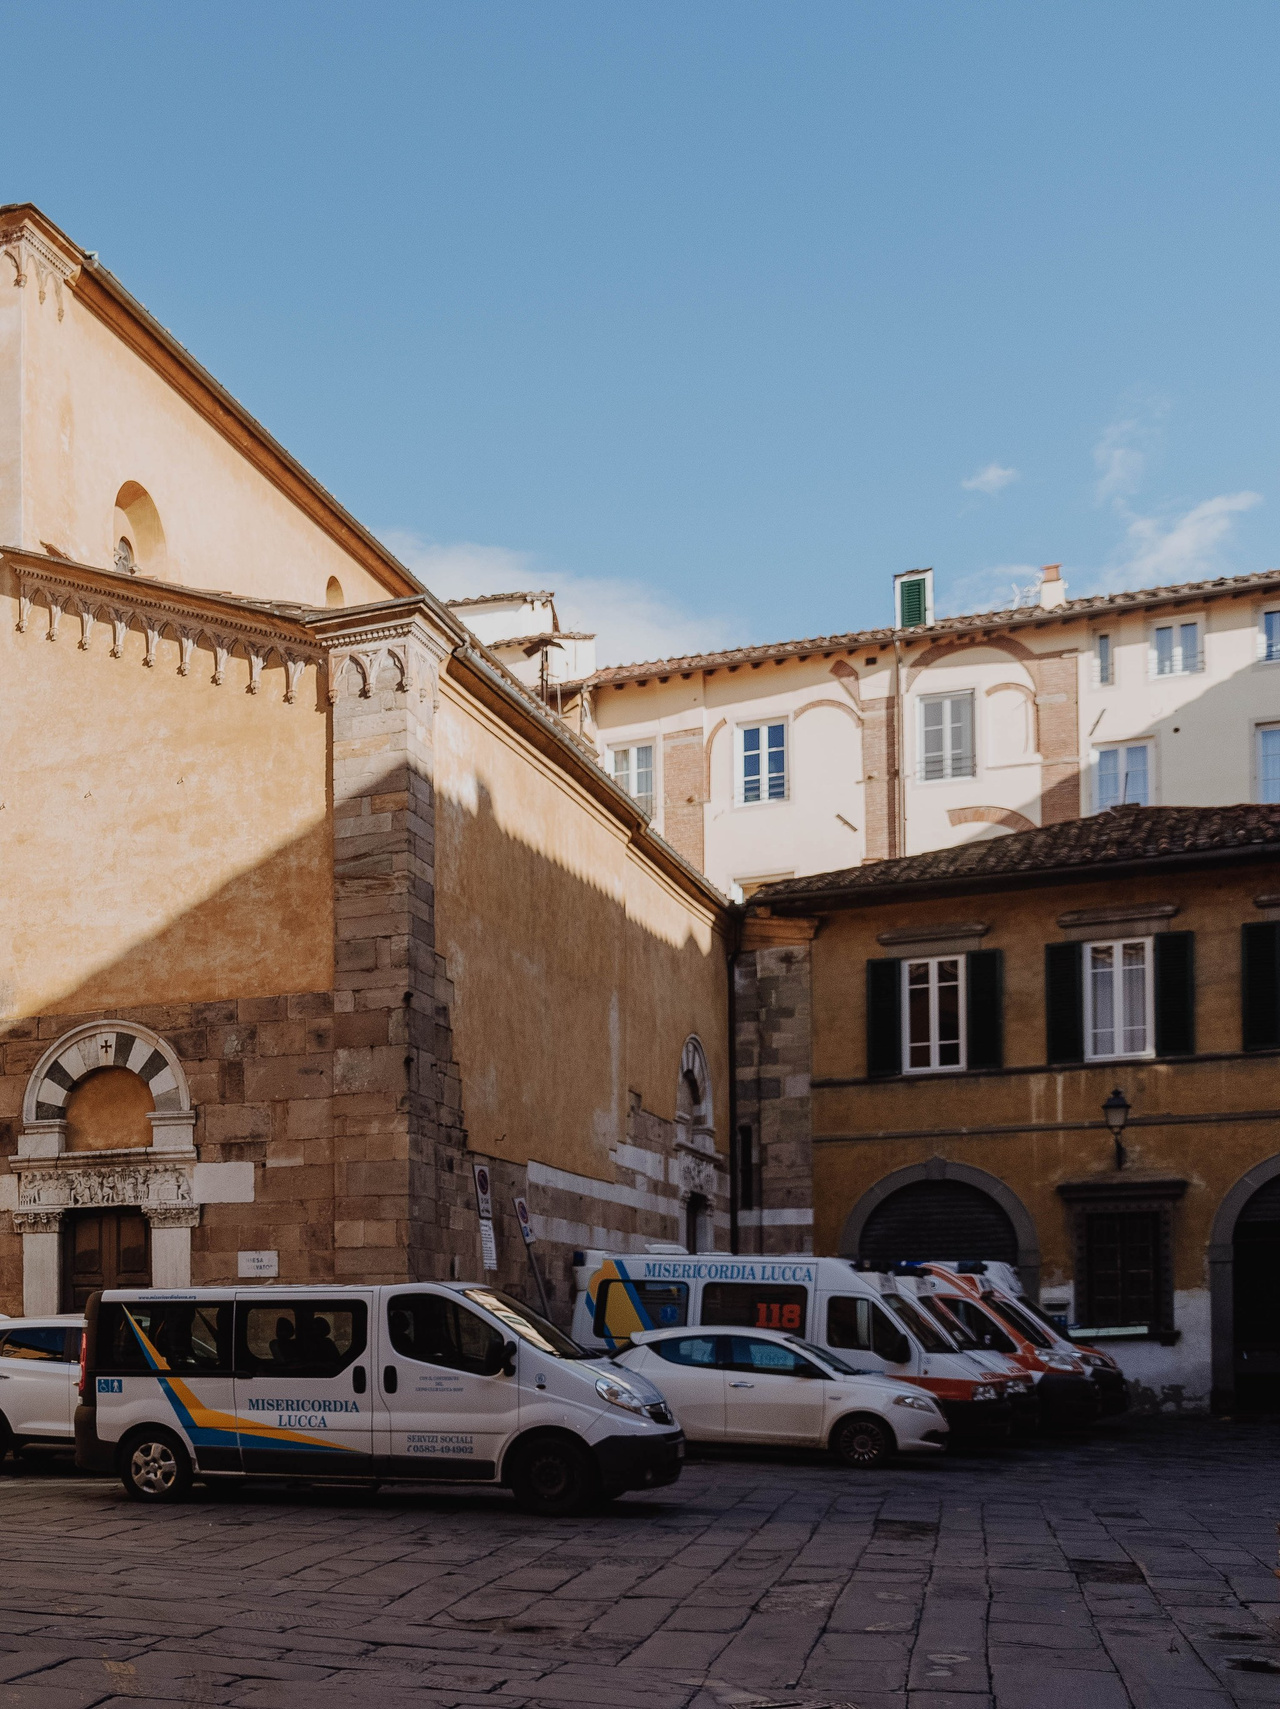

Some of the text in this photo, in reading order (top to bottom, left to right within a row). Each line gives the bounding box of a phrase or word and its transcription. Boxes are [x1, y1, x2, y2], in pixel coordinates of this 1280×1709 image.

[644, 1263, 813, 1282] MISERICORDIA LUCCA
[756, 1303, 801, 1328] 118
[248, 1398, 360, 1413] MISERICORDIA
[277, 1414, 328, 1428] LUCCA
[407, 1434, 473, 1444] SERVIZI SOCIALI
[413, 1445, 474, 1454] 0583-494902
